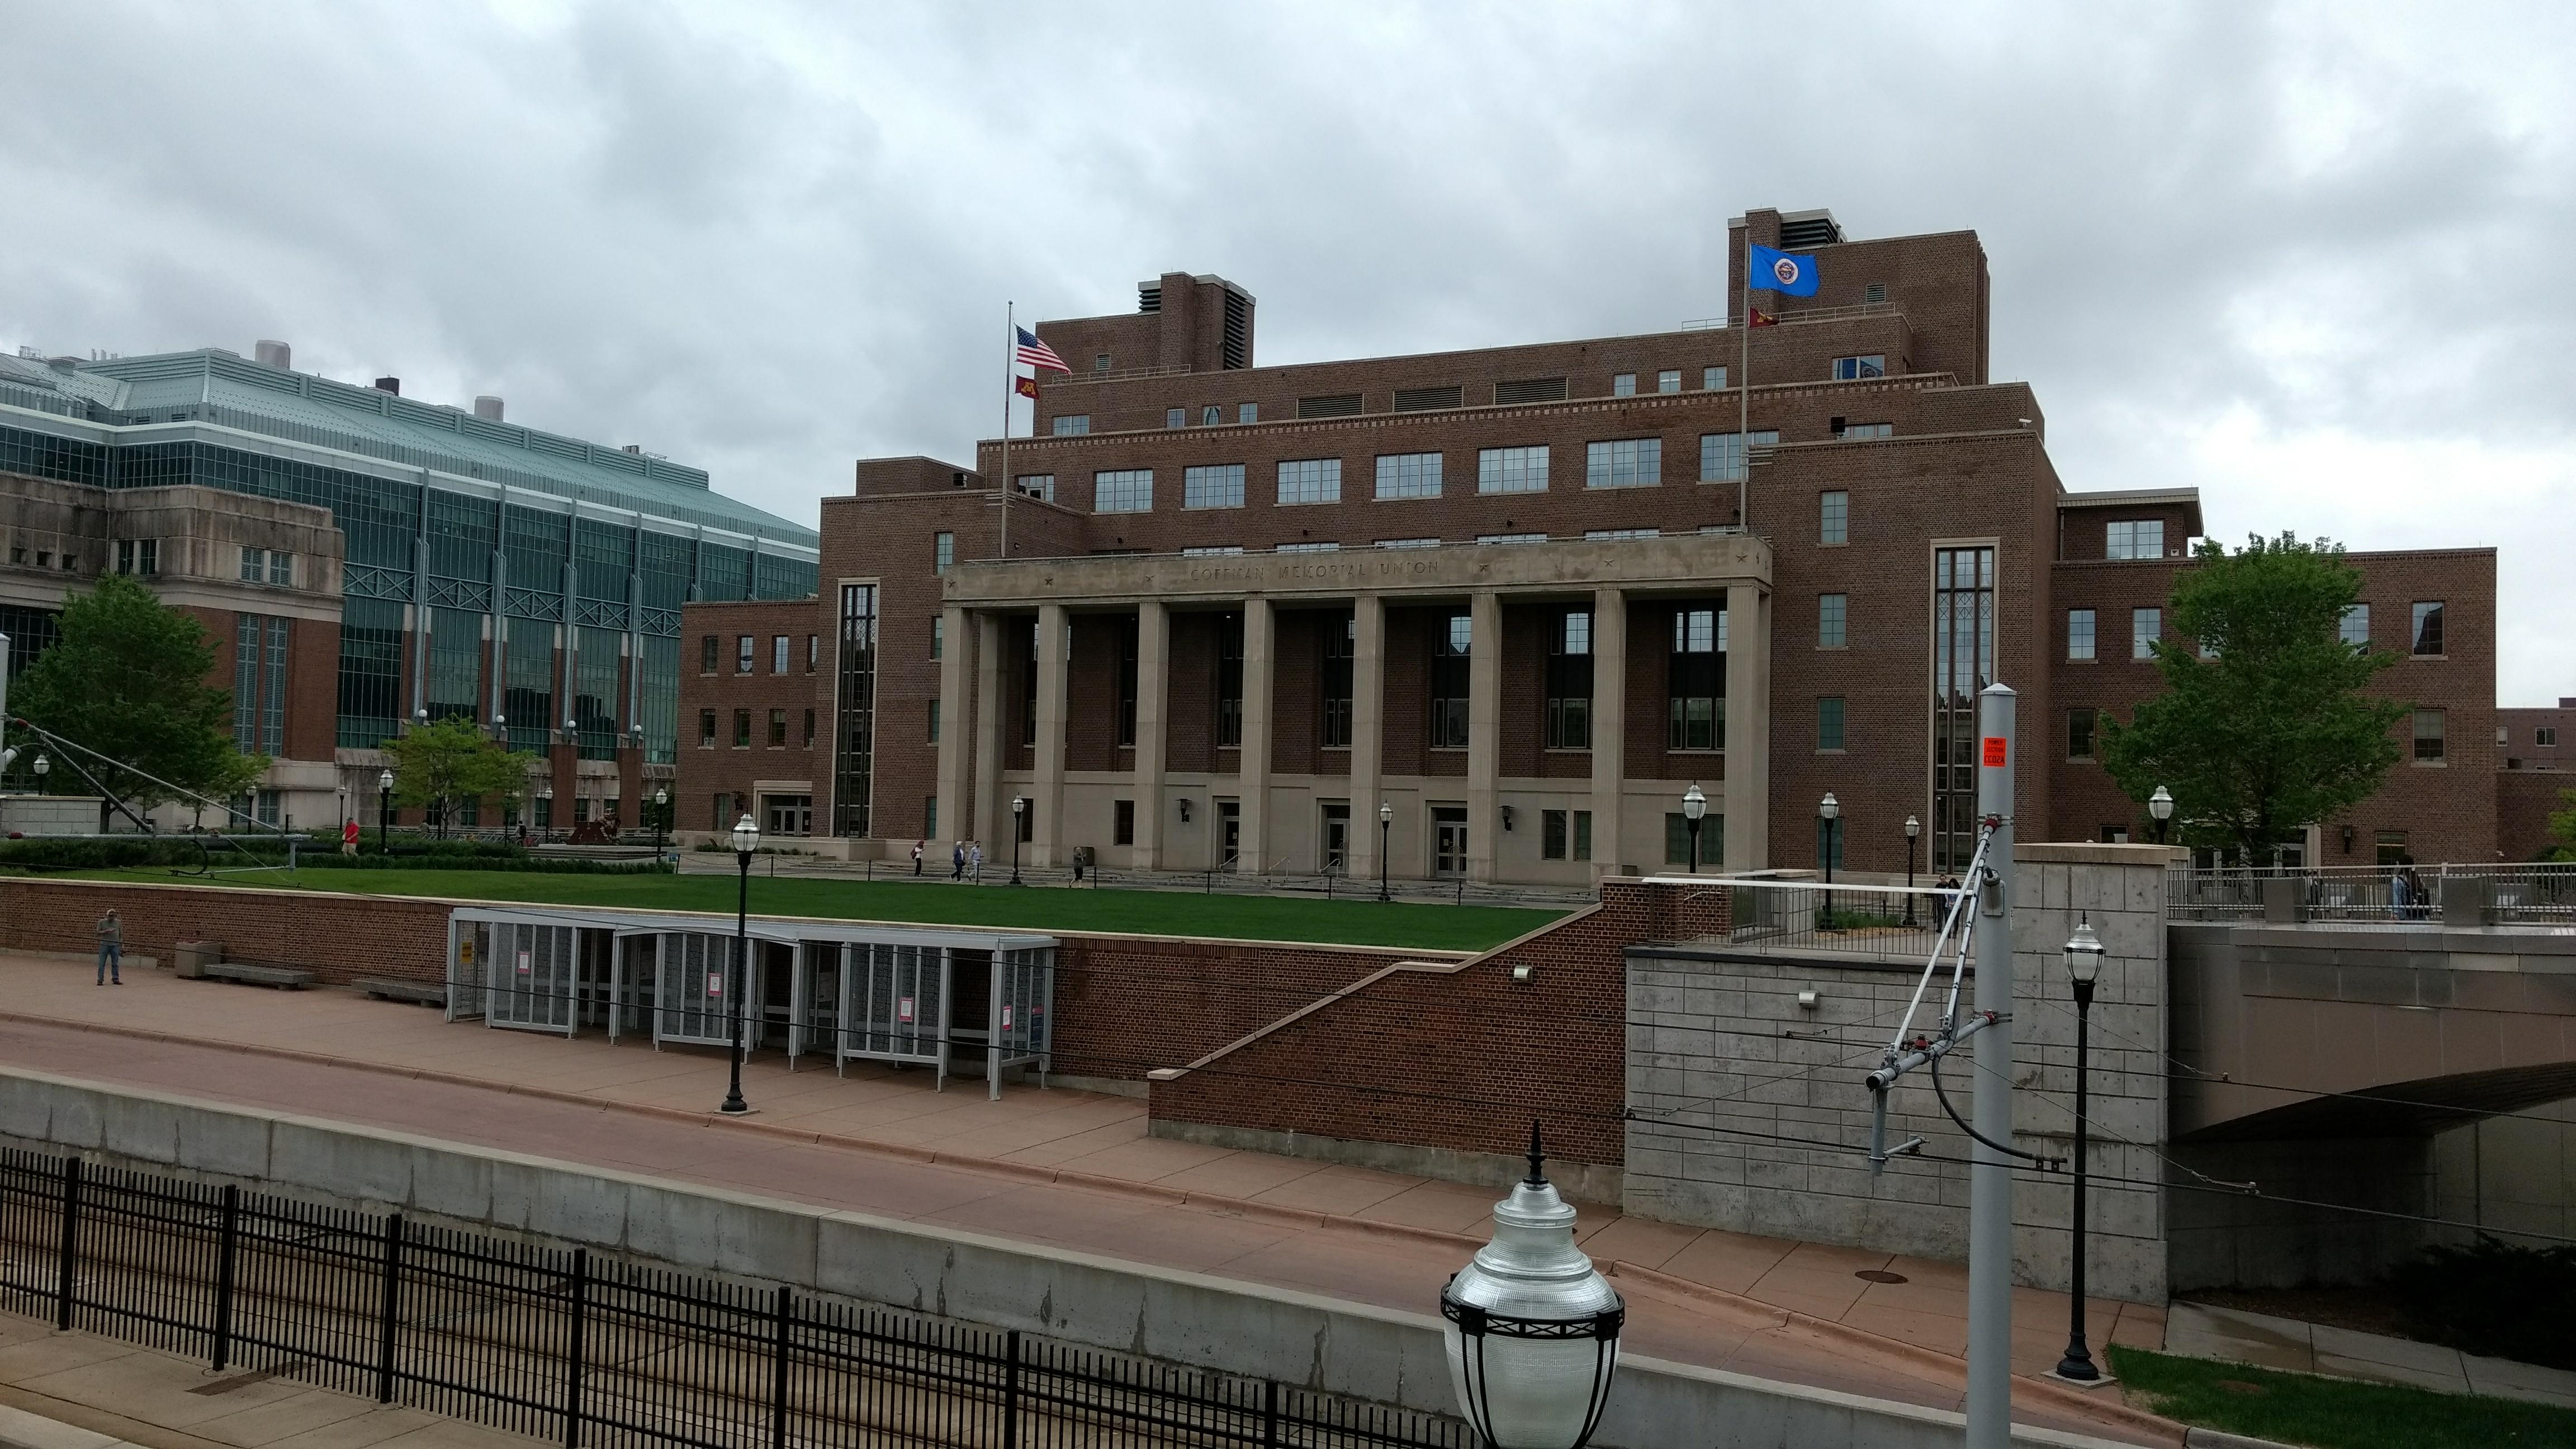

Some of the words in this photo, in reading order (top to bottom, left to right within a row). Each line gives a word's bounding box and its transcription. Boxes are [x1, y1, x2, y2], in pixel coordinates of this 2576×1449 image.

[1021, 381, 1036, 395] M
[1191, 567, 1264, 581] COFFMAN
[1278, 564, 1366, 580] MEMORIAL
[1380, 561, 1438, 575] UNION
